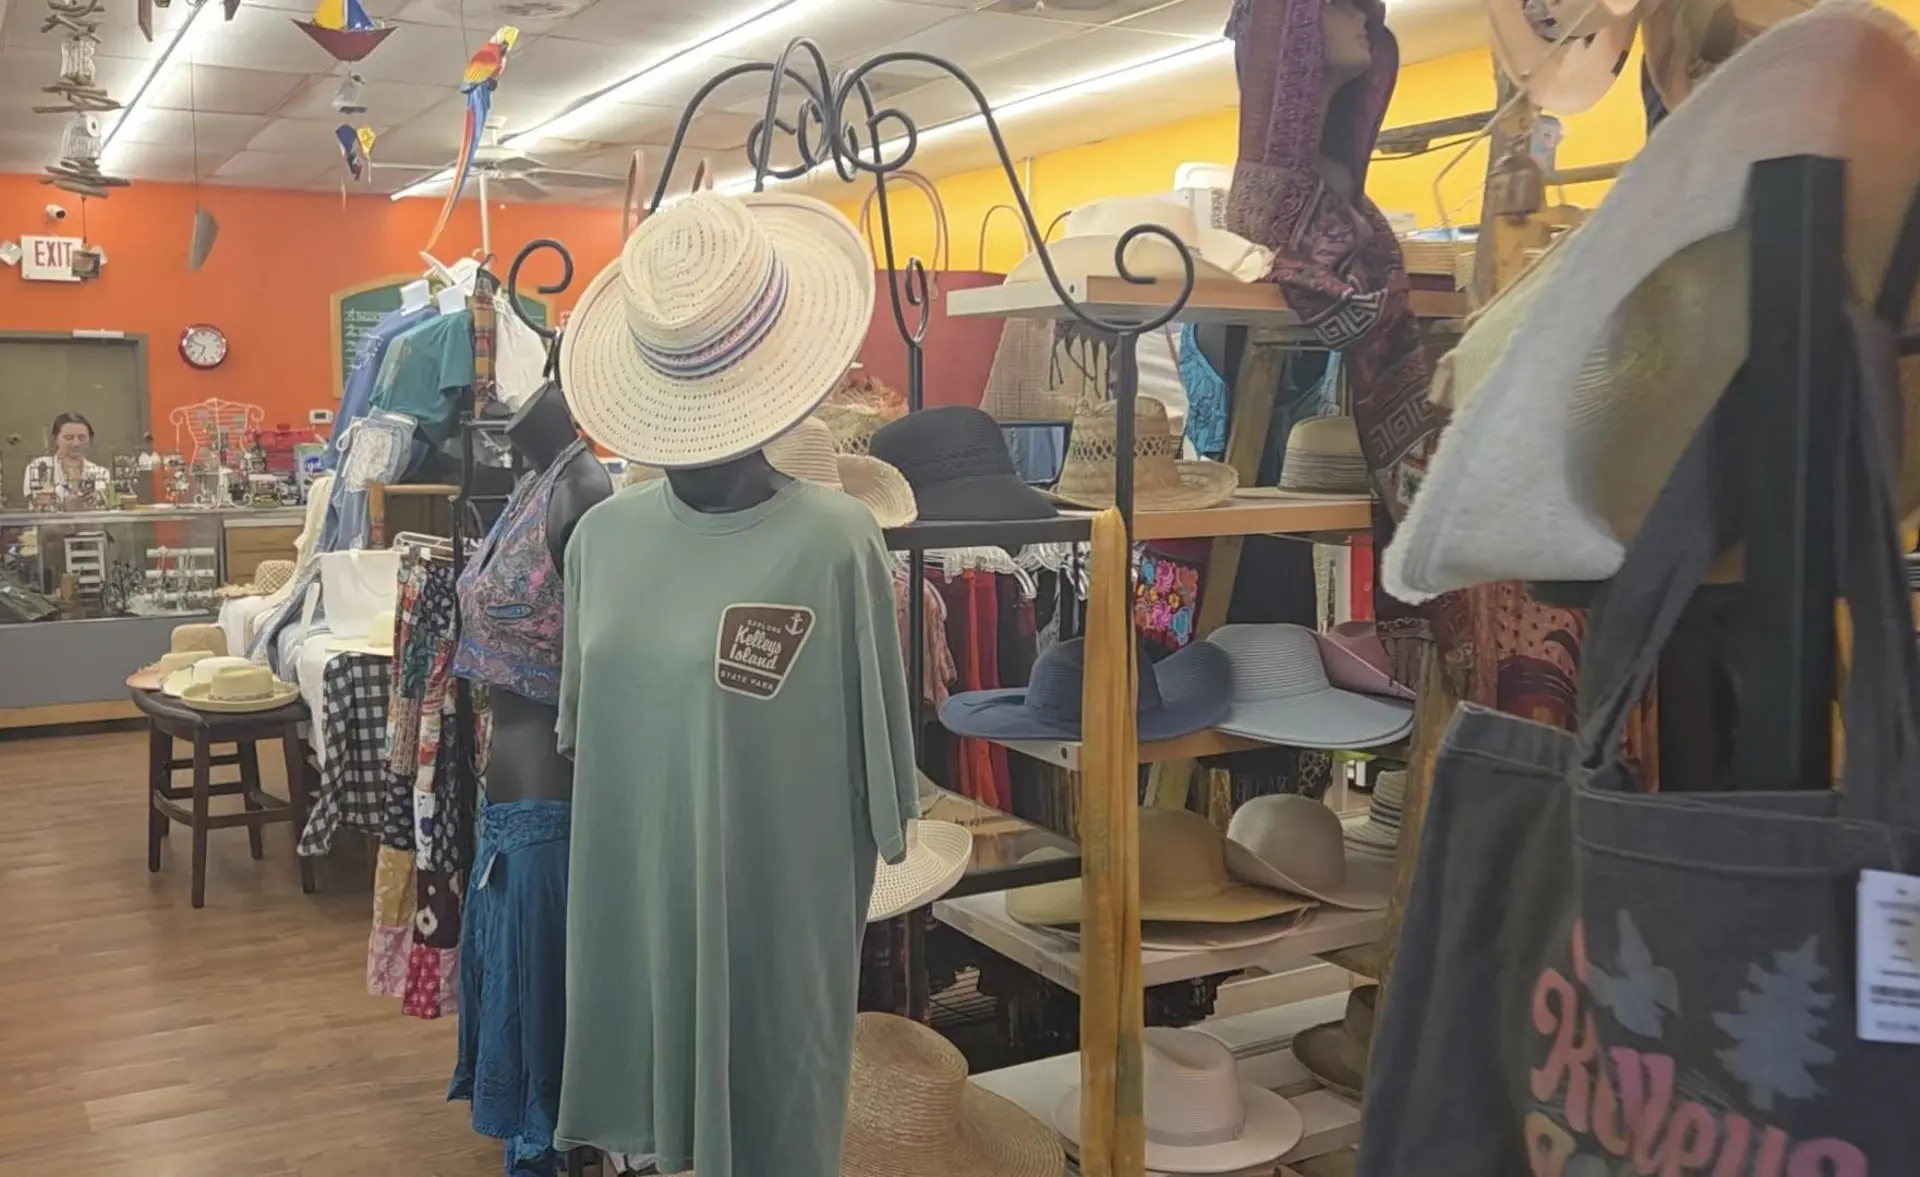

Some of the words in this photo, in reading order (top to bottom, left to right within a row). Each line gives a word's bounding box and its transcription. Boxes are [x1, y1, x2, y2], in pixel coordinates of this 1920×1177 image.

[34, 240, 73, 267] EXIT
[747, 619, 781, 634] EXPLORE
[735, 624, 782, 657] Kelleys
[729, 643, 778, 670] Island
[721, 670, 748, 683] STATE
[750, 677, 774, 690] PARK
